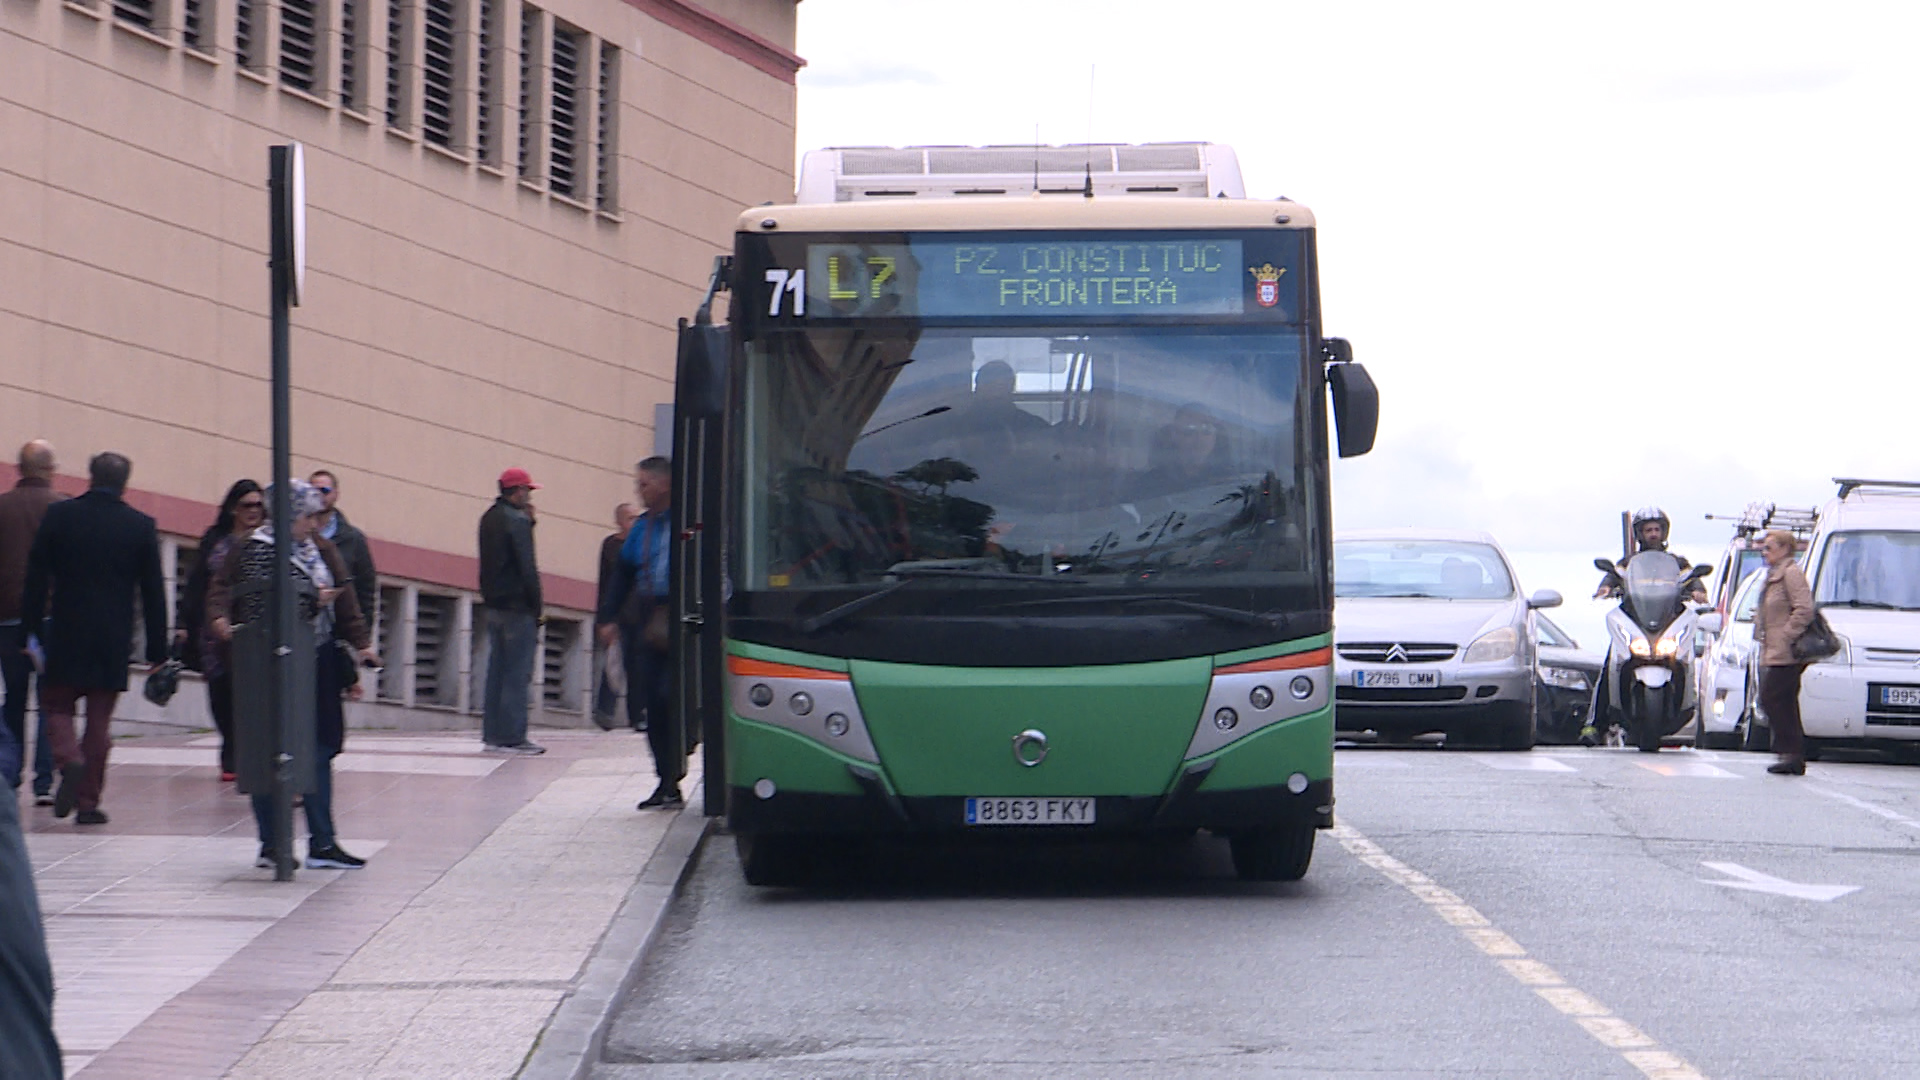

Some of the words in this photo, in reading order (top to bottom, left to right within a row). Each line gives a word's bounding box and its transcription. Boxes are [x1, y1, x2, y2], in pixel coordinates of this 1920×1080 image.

[955, 246, 1006, 275] PZ.
[1022, 244, 1222, 274] CONSTITUC
[764, 268, 806, 317] 71
[828, 256, 896, 299] L7
[999, 276, 1178, 306] FRONTERA
[1366, 671, 1400, 686] 2796
[1891, 689, 1920, 704] 995
[981, 800, 1039, 821] 8863
[1046, 800, 1089, 820] FKY
